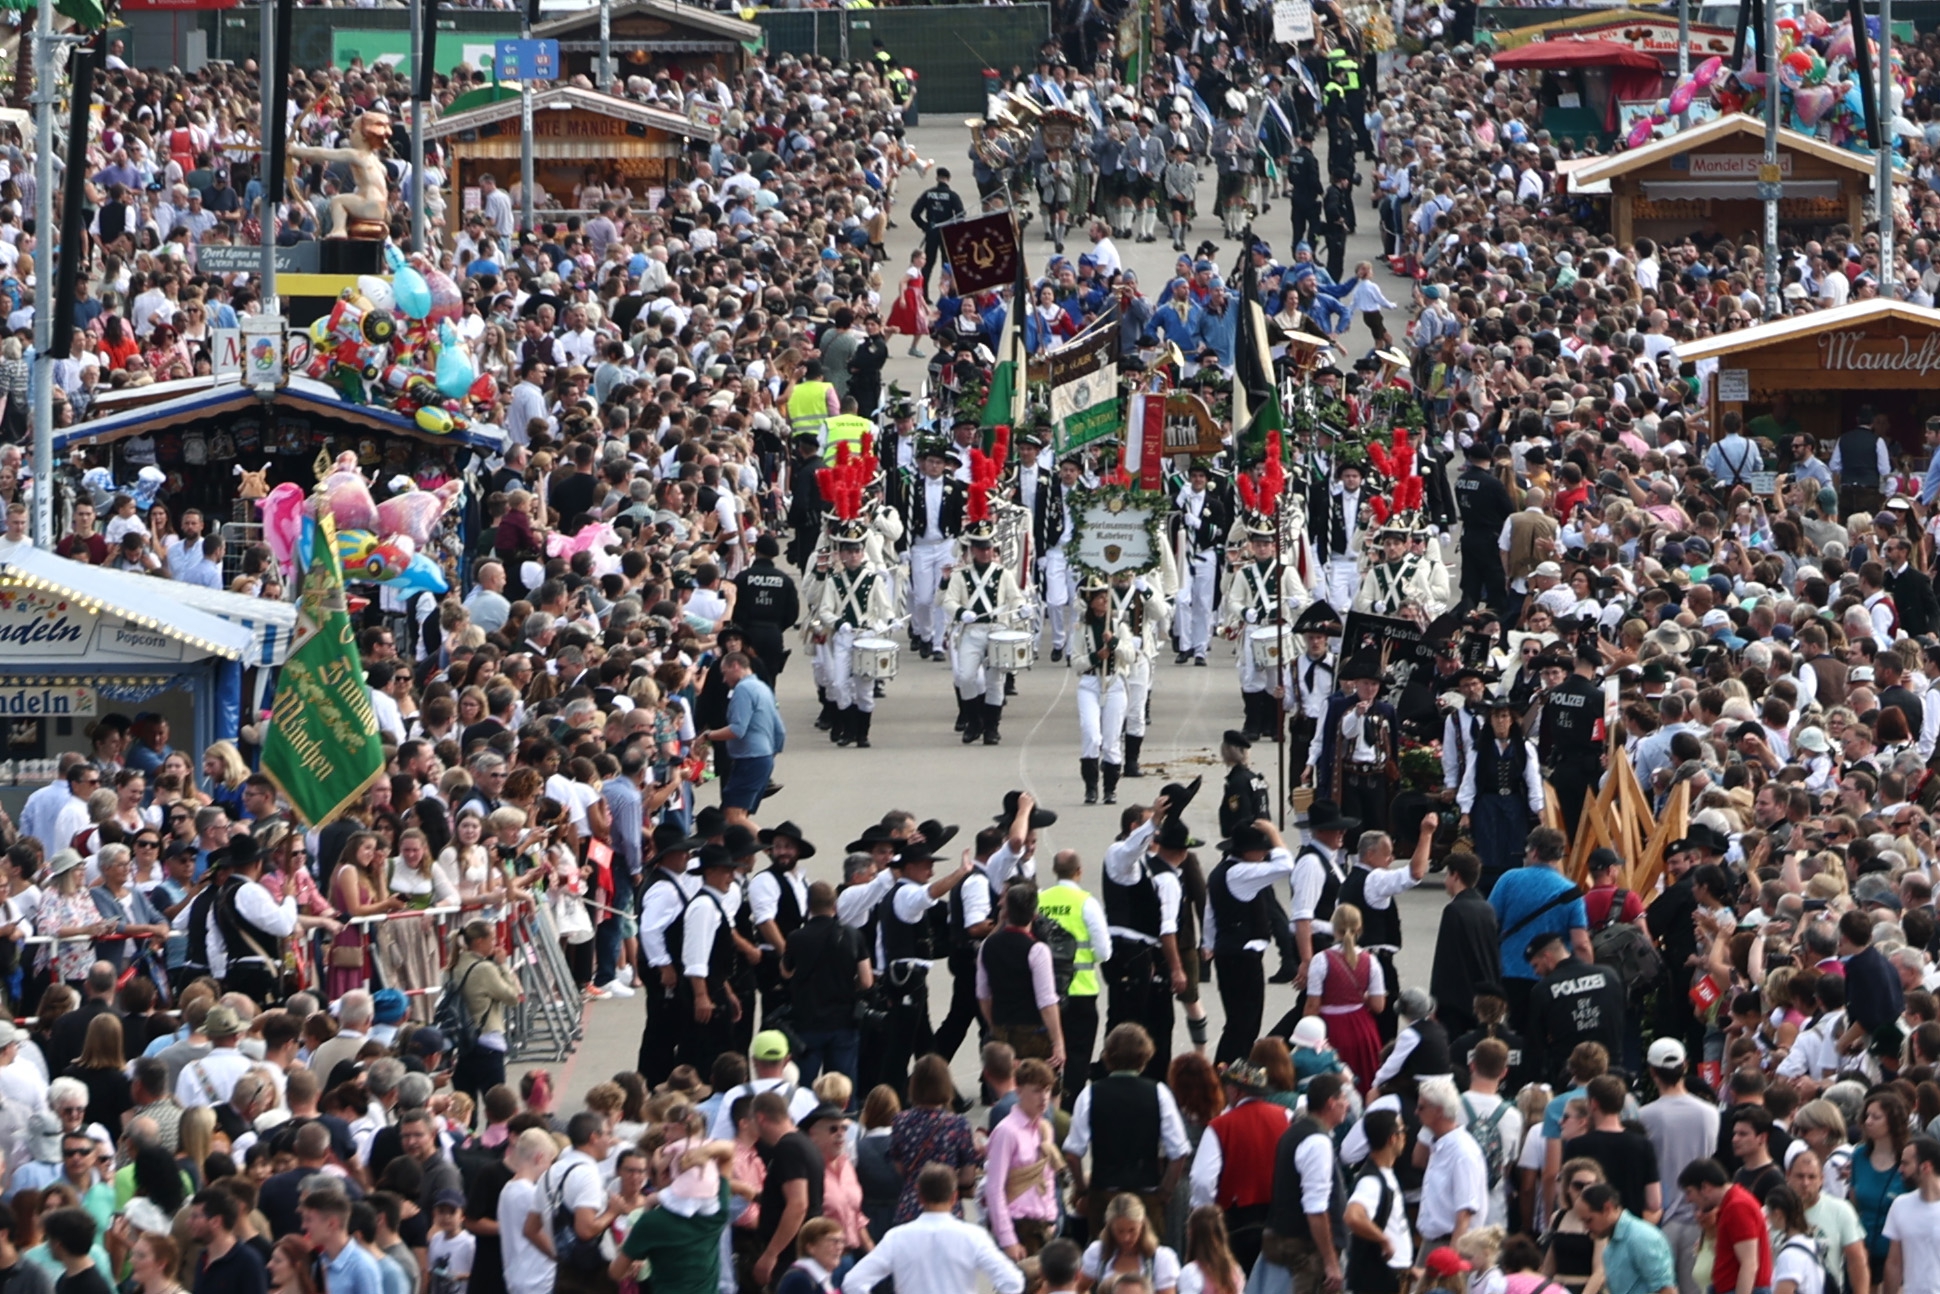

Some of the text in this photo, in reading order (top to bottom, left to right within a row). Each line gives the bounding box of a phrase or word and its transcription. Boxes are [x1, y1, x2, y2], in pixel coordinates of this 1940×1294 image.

[1694, 158, 1744, 171] Mandel
[747, 575, 783, 588] POLIZEI
[116, 629, 167, 648] Popcorn
[1550, 692, 1585, 708] POLIZEI
[1551, 973, 1607, 999] POLIZEI
